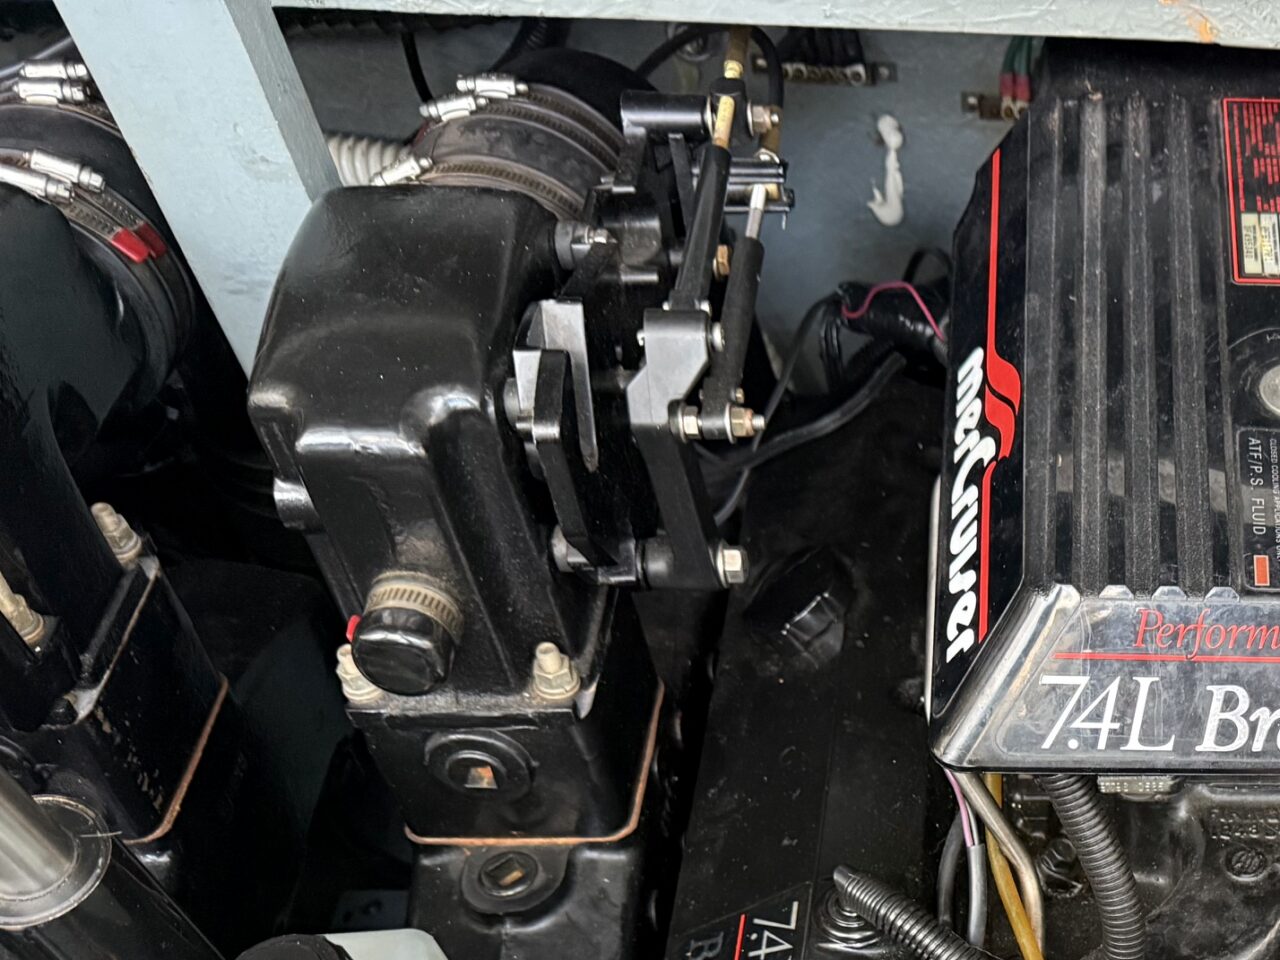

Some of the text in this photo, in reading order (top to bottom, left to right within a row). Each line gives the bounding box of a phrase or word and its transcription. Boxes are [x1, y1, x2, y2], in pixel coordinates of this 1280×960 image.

[1269, 438, 1278, 464] CLOSED
[1248, 437, 1267, 535] ATF/P.S. FLUID
[1271, 465, 1280, 495] COOLING
[1039, 675, 1176, 752] 7.4L
